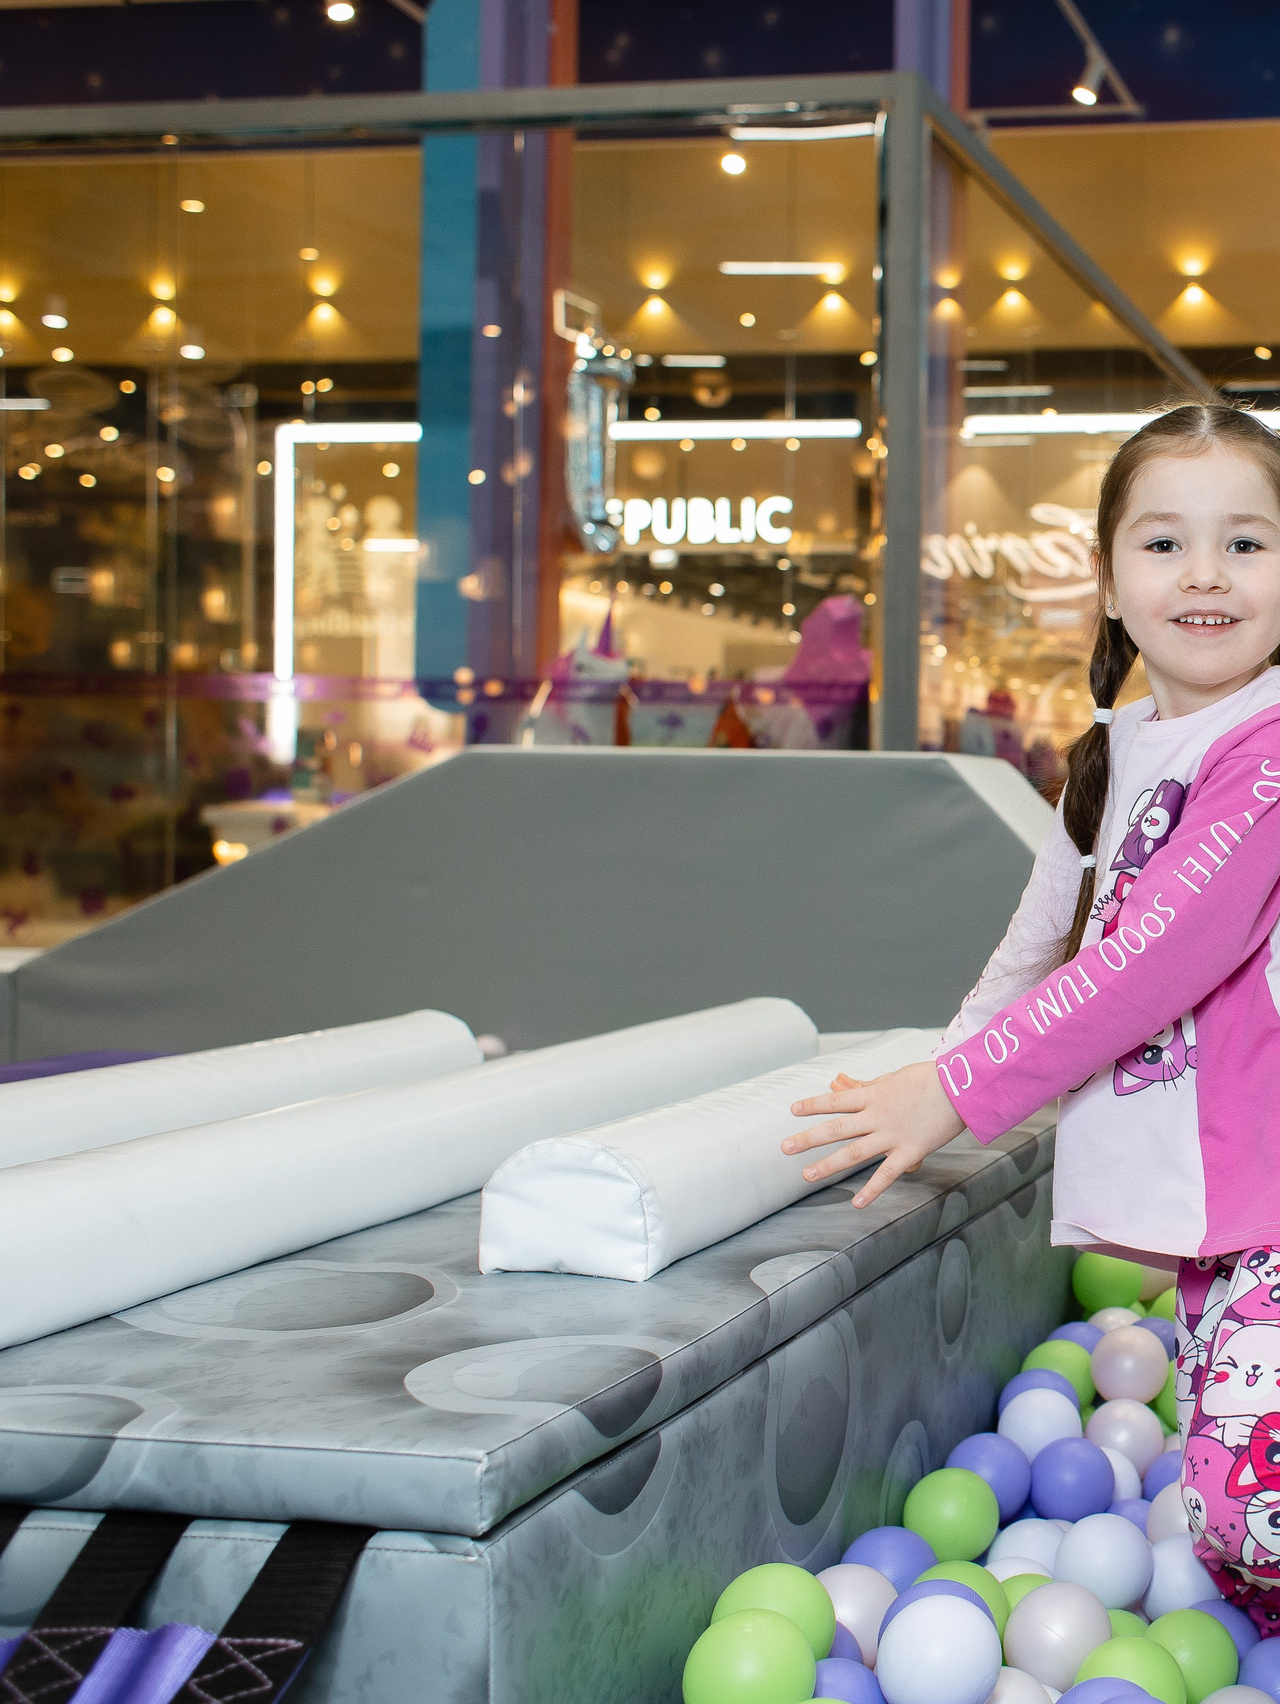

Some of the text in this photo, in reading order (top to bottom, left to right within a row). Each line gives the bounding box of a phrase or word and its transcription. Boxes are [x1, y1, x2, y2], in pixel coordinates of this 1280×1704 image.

[605, 496, 793, 544] PUBLIC
[1098, 892, 1176, 971] SOOO
[1026, 964, 1098, 1034] FUN!
[984, 1016, 1019, 1064] SO
